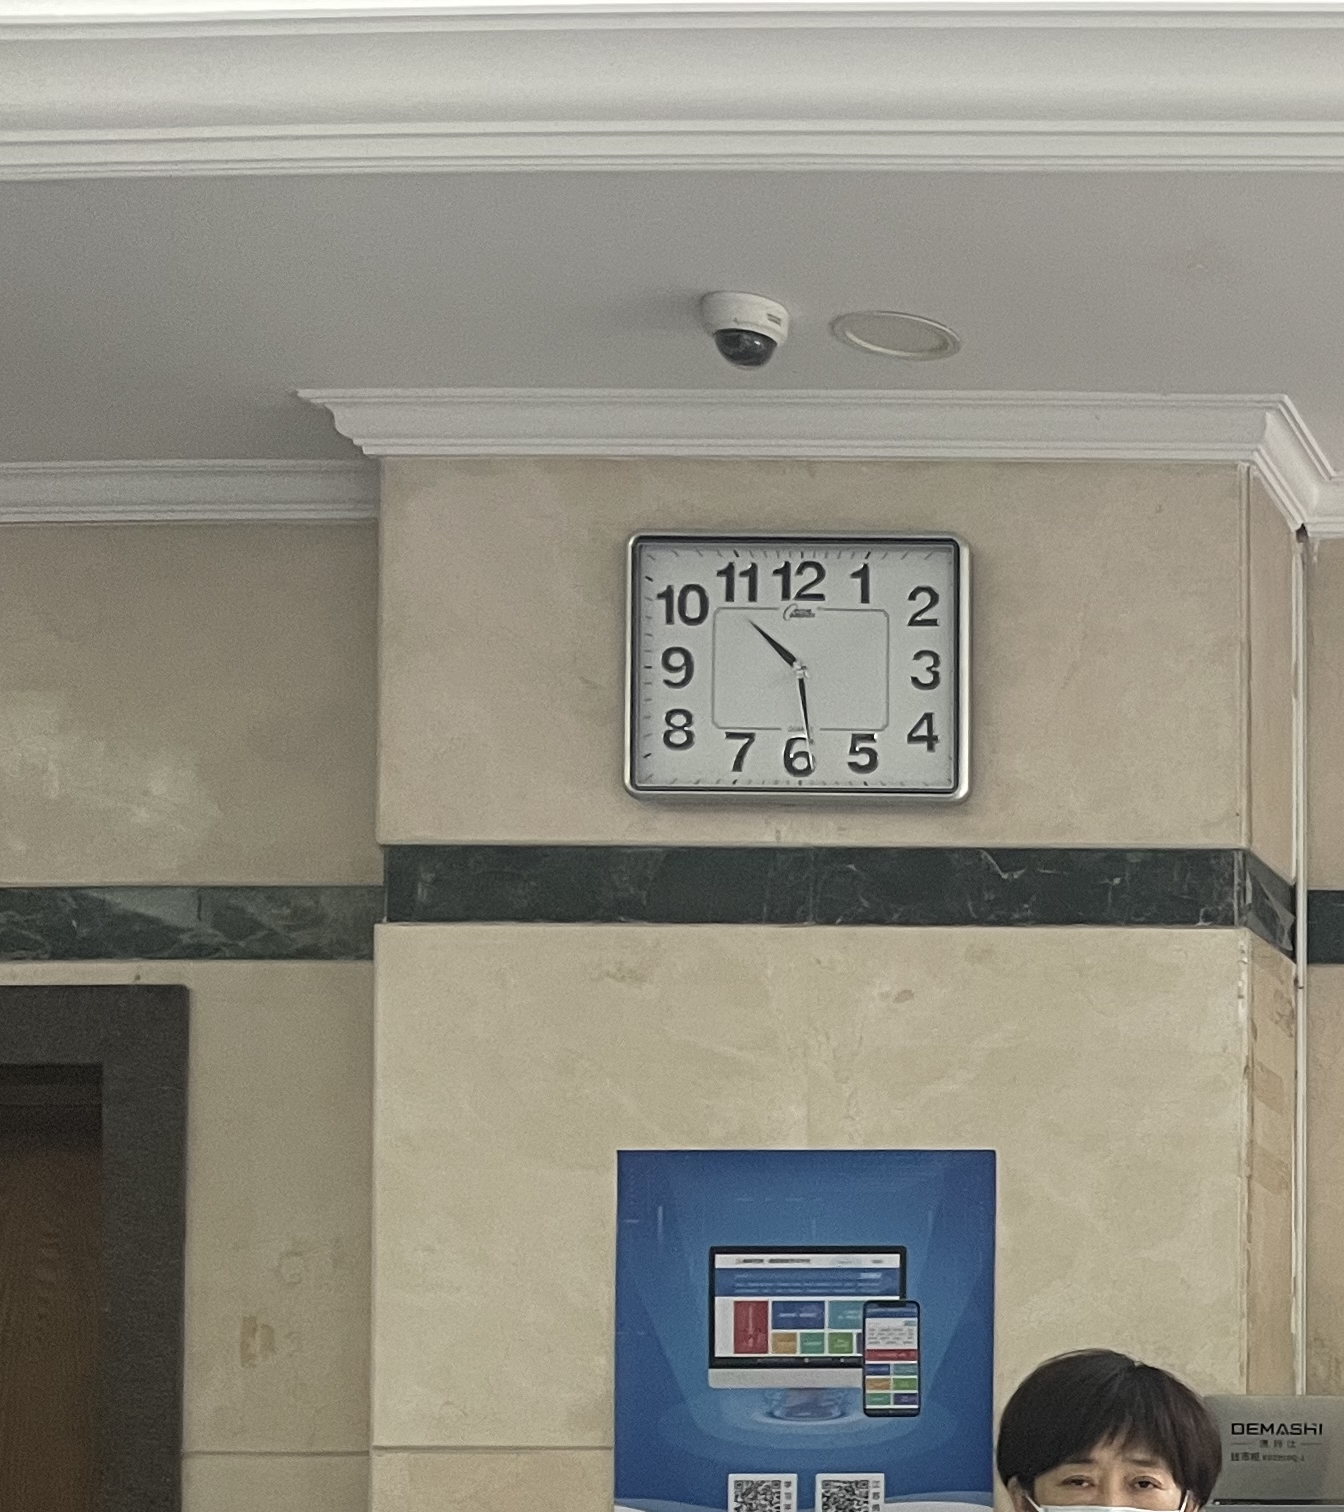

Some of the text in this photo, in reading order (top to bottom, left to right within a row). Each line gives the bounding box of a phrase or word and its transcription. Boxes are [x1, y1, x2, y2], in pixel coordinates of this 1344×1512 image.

[717, 561, 758, 602] 11
[772, 561, 826, 601] 12
[850, 563, 870, 603] 1
[657, 584, 709, 625] 10
[907, 586, 939, 626] 2
[661, 647, 694, 689] 9
[910, 650, 940, 690] 3
[663, 708, 695, 750] 8
[907, 712, 939, 752] 4
[725, 732, 755, 772] 7
[783, 737, 816, 777] 6
[848, 733, 878, 774] 5
[1231, 1422, 1323, 1436] DEMASHI
